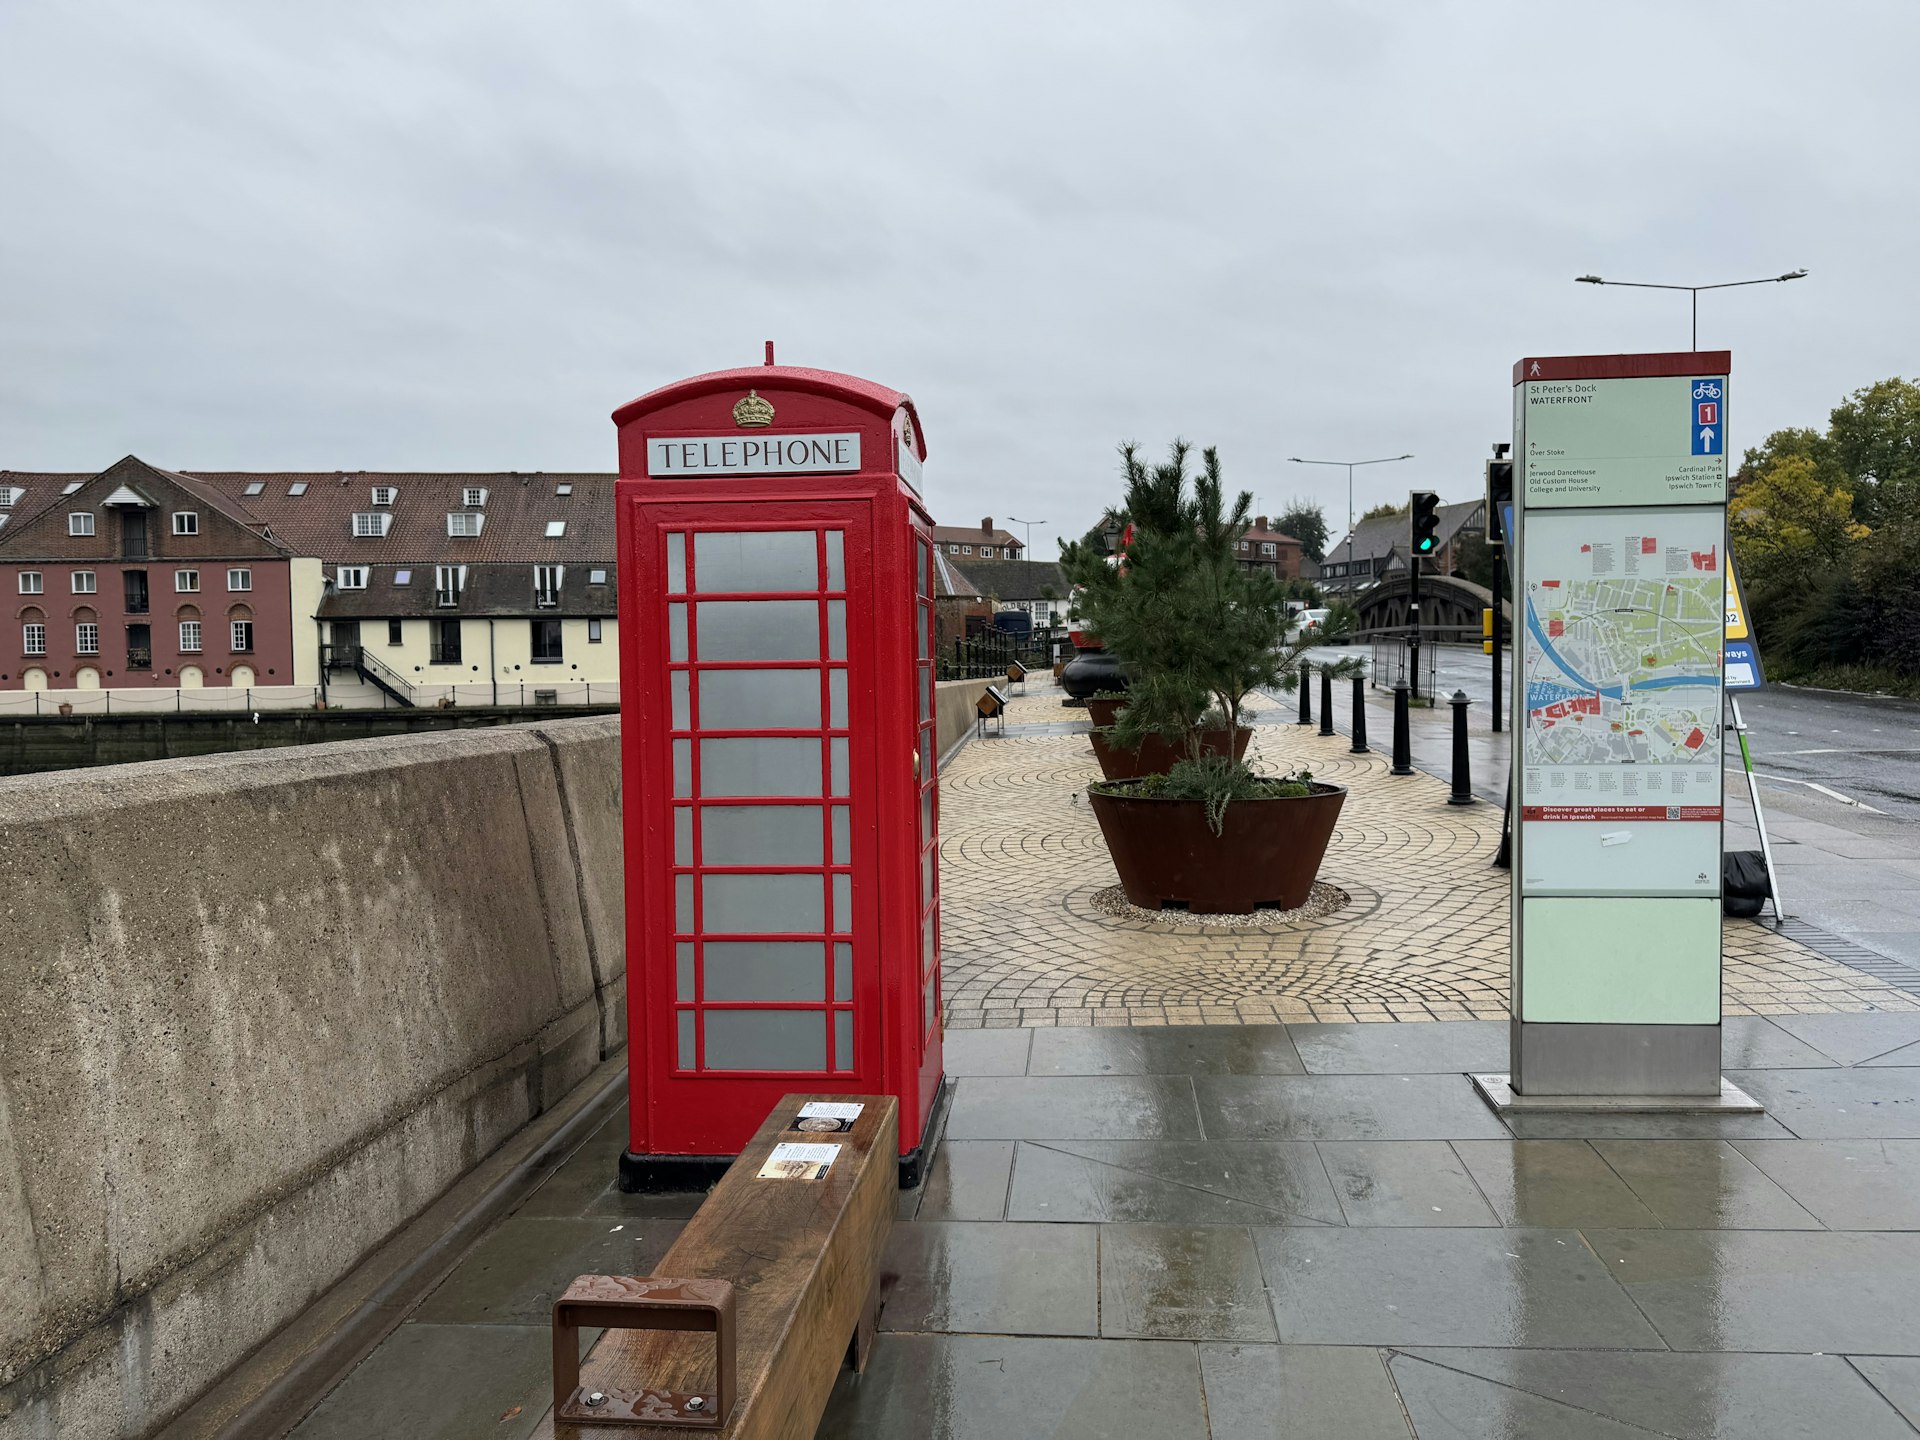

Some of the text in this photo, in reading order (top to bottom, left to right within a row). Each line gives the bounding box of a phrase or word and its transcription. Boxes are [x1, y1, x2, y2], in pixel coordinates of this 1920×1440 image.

[1531, 383, 1597, 394] St Peter's Dock
[1531, 395, 1593, 405] WATERFRONT
[1705, 406, 1712, 421] 1
[657, 438, 850, 468] TELEPHONE
